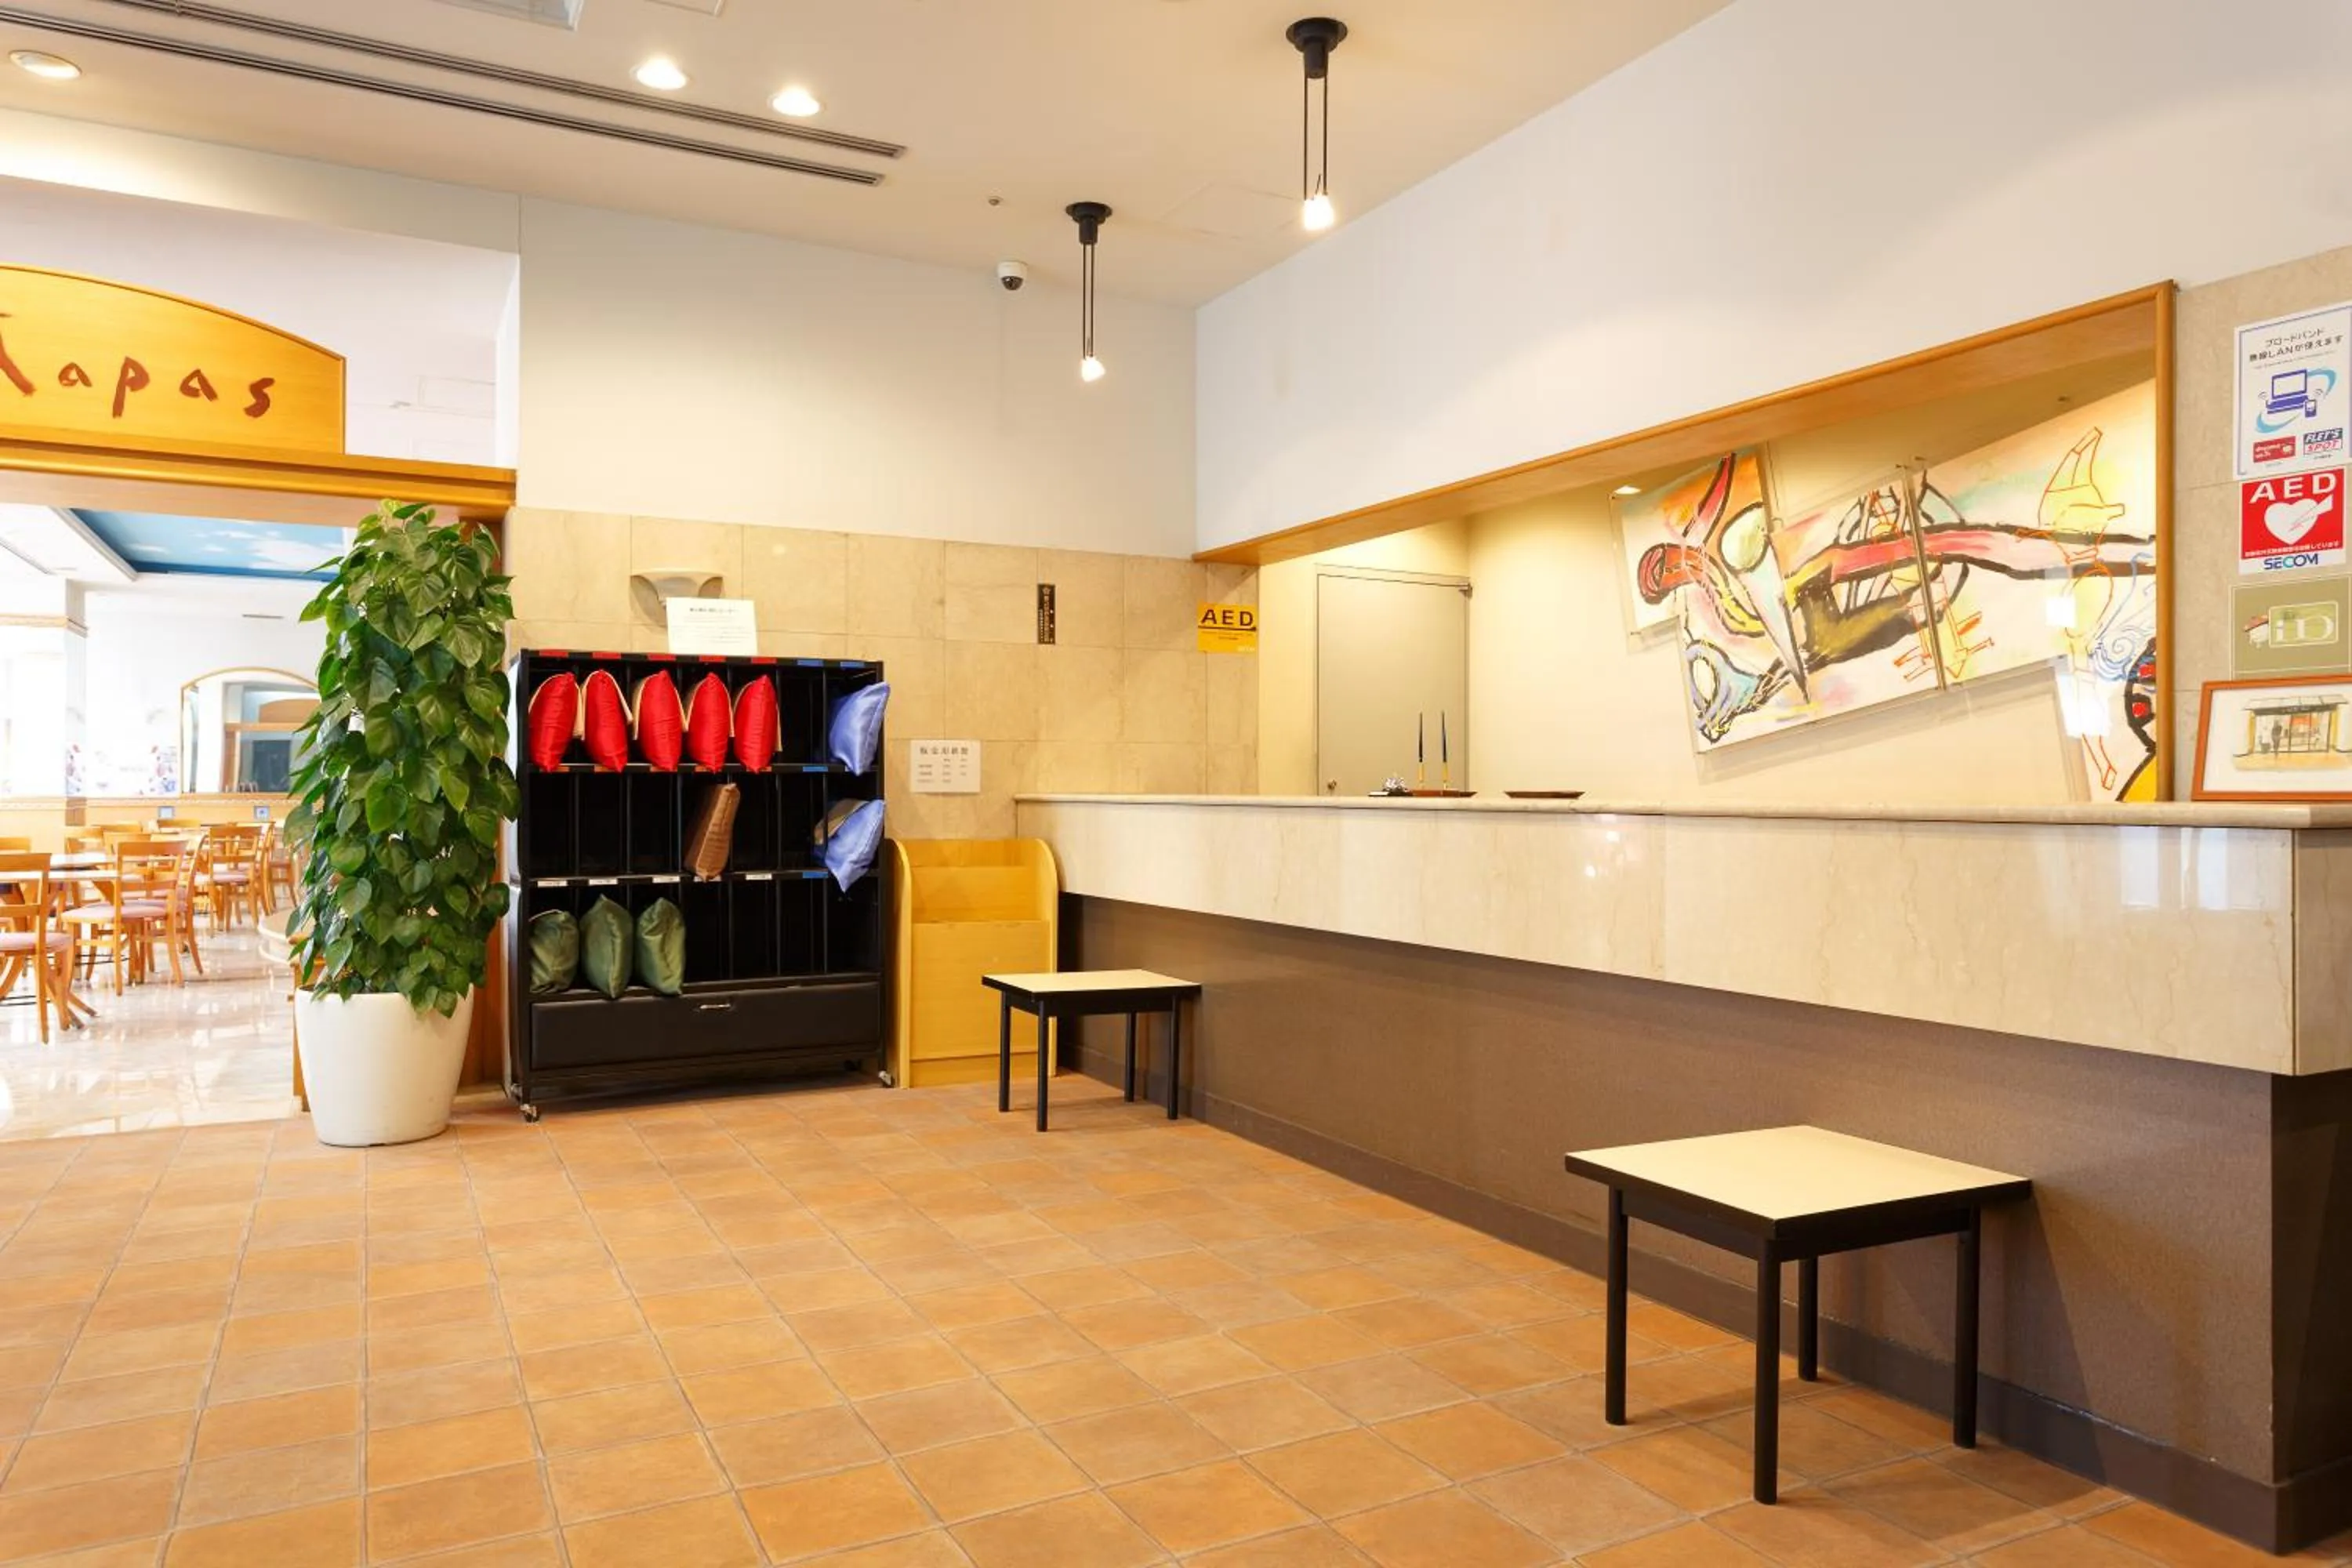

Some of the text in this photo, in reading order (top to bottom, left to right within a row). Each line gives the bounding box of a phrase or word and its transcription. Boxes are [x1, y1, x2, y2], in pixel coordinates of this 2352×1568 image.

[2307, 439, 2339, 452] SPOT
[2249, 473, 2337, 504] AED
[2263, 553, 2319, 570] SECOM
[1201, 609, 1254, 626] AED
